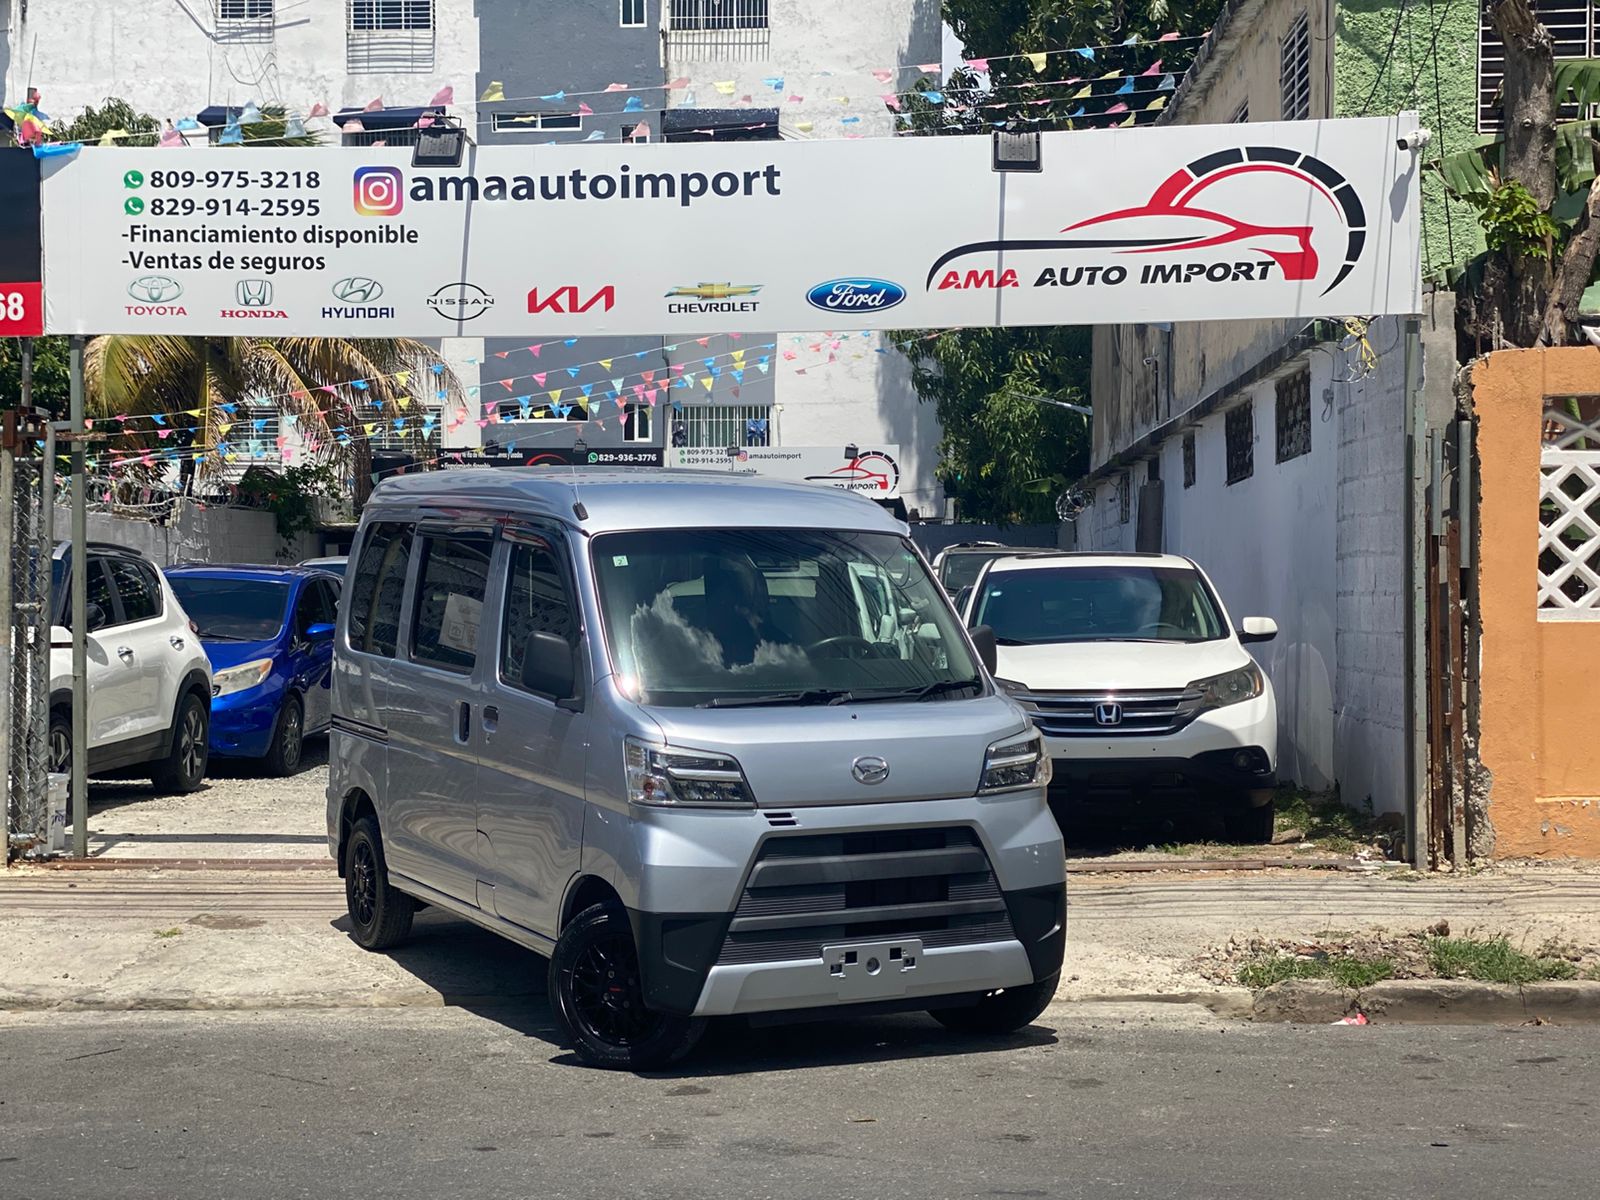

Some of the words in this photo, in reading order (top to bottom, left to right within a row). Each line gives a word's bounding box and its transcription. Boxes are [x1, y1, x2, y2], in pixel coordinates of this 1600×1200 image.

[150, 170, 321, 189] 809-975-3218
[409, 164, 781, 206] amaautoimport
[150, 198, 321, 217] 829-914-2595
[121, 224, 298, 244] -Financiamiento
[303, 225, 419, 248] disponible
[121, 251, 202, 270] -Ventas
[208, 251, 235, 270] de
[240, 254, 326, 274] seguros
[937, 268, 1020, 290] AMA
[1033, 266, 1127, 287] AUTO
[1140, 260, 1276, 284] IMPORT
[426, 298, 495, 306] NISSAN
[527, 285, 615, 314] KIA
[826, 283, 886, 308] Ford
[124, 305, 188, 316] TOYOTA
[220, 309, 289, 319] HONDA
[321, 307, 395, 319] HYUNDAI
[668, 301, 761, 314] CHEVROLET
[598, 453, 657, 462] 829-936-3776
[749, 452, 802, 460] amaautoimport
